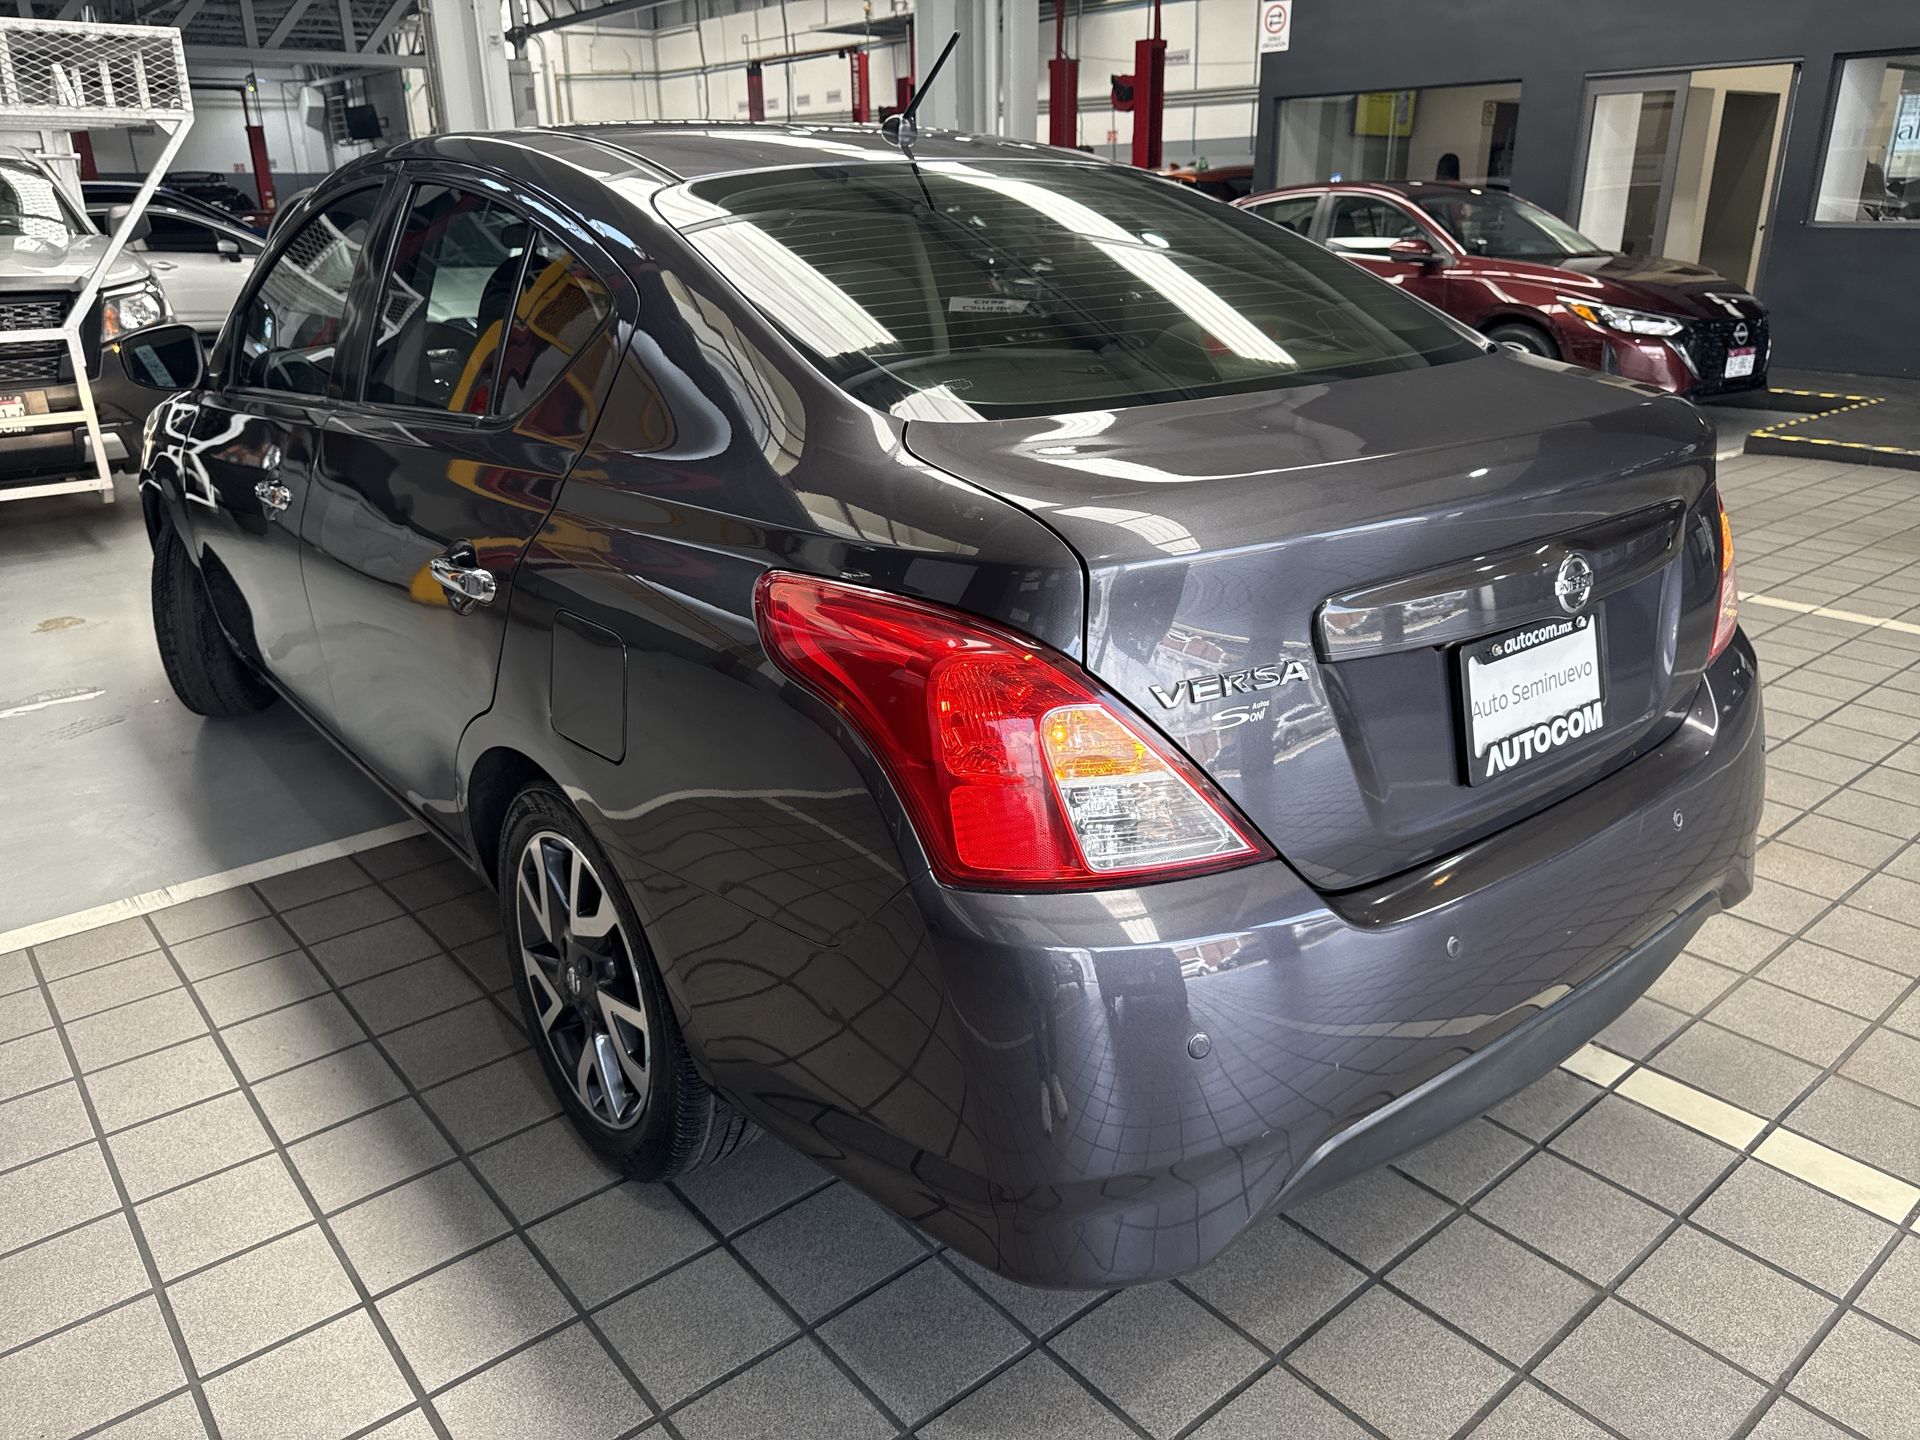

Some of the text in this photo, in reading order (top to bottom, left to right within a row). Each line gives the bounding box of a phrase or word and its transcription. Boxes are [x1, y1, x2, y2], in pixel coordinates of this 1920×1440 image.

[1503, 621, 1573, 654] autocom.mx
[1148, 660, 1310, 709] VERSA
[1252, 700, 1270, 710] Autos
[1472, 661, 1593, 719] Auto Seminuevo
[1485, 701, 1604, 777] AUTOCOM
